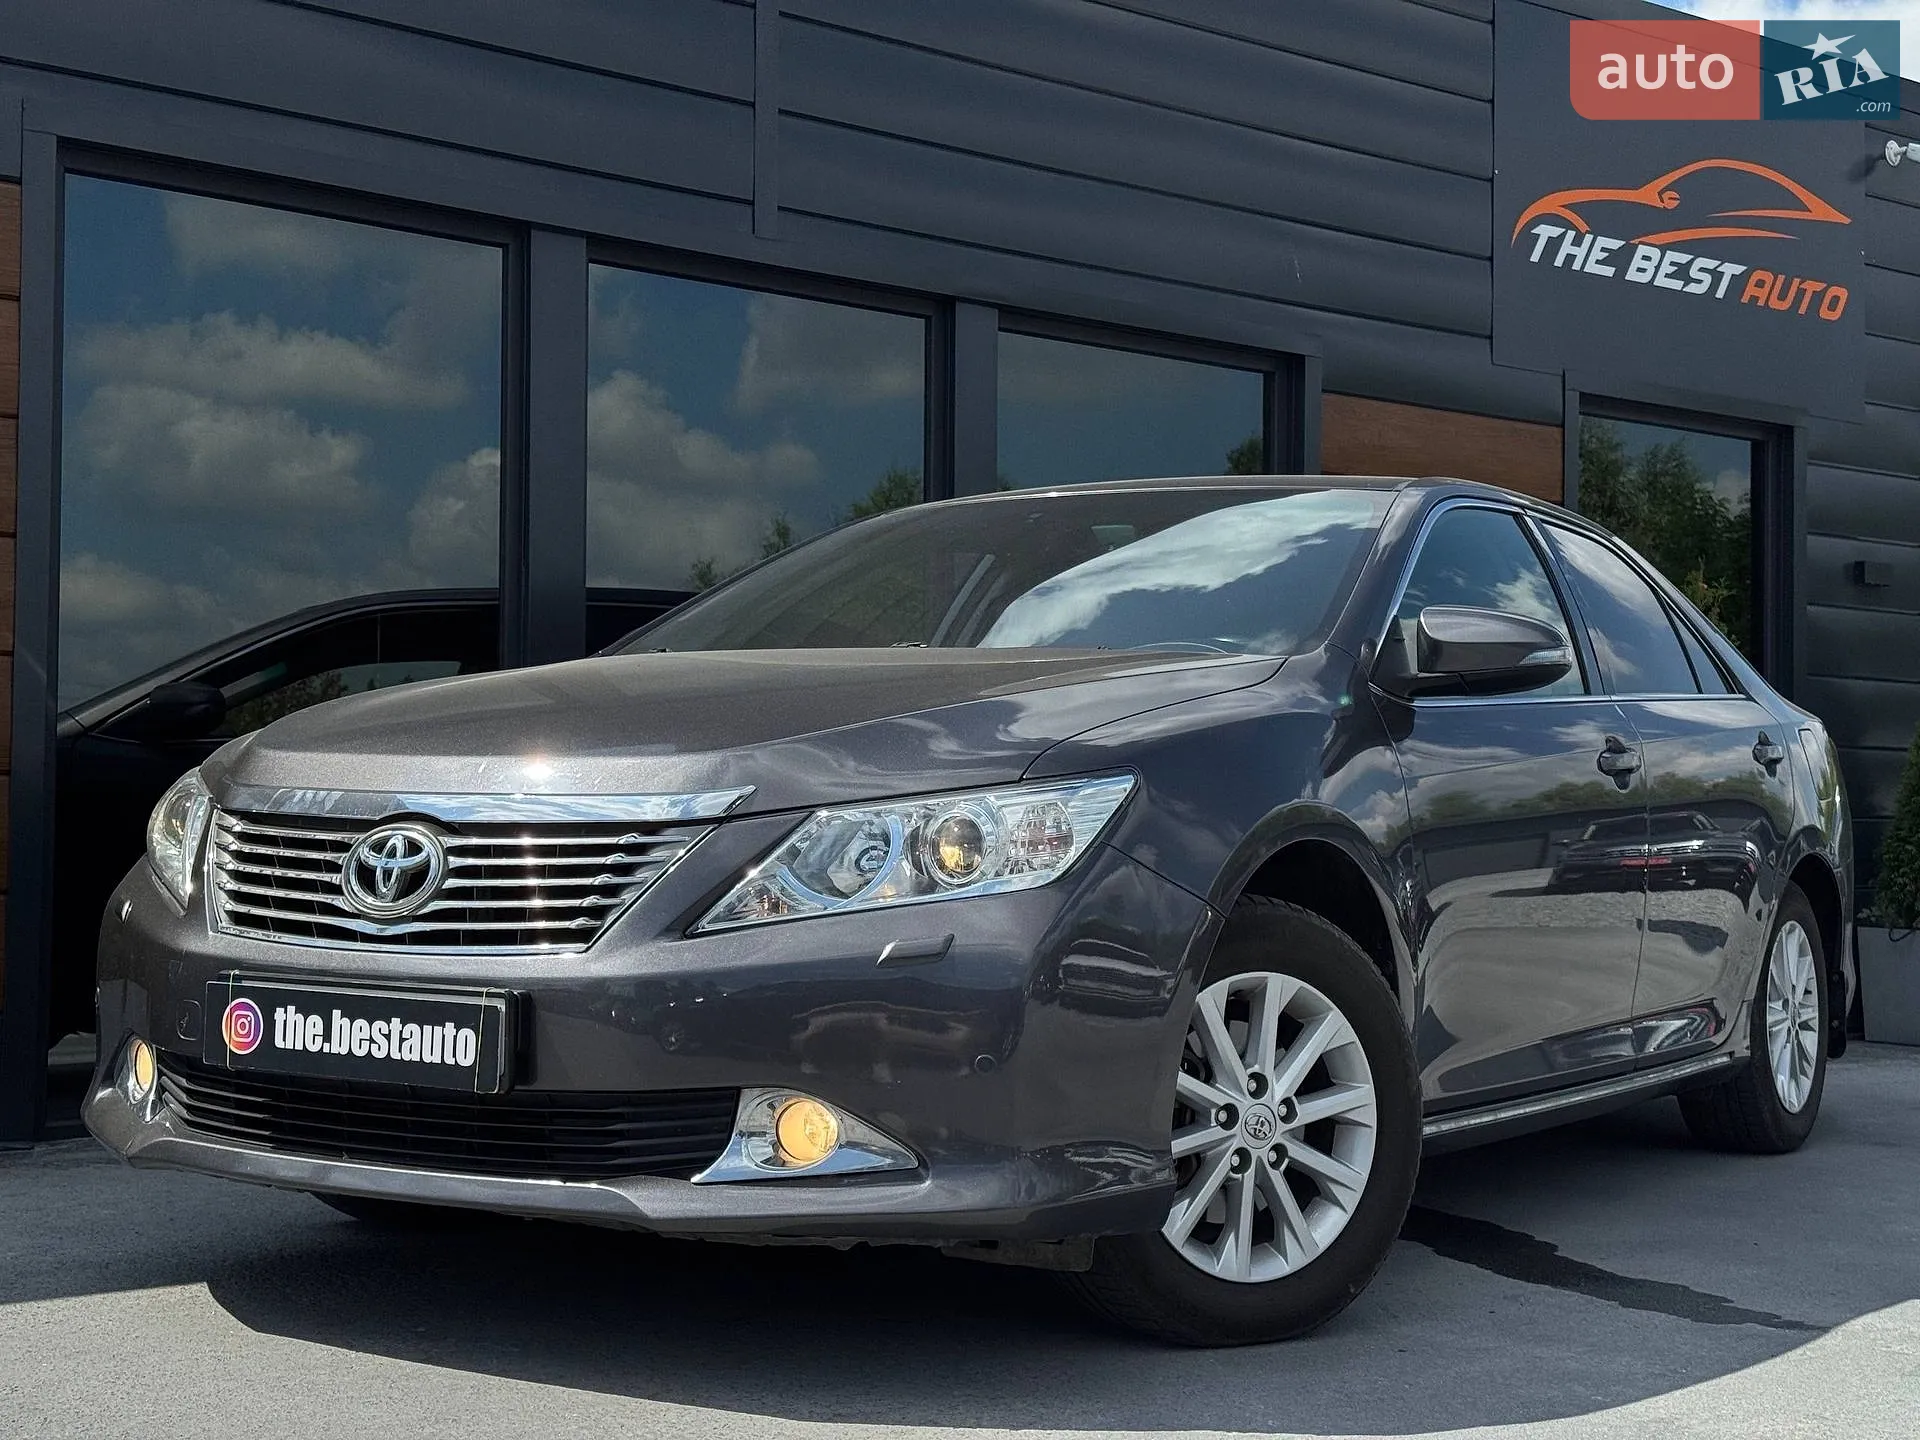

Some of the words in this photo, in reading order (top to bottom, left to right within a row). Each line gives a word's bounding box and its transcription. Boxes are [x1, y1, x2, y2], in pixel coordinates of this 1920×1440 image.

[1529, 223, 1626, 278] THE
[1624, 243, 1747, 299] BEST
[1740, 269, 1849, 322] AUTO
[273, 1005, 477, 1067] the.bestauto
